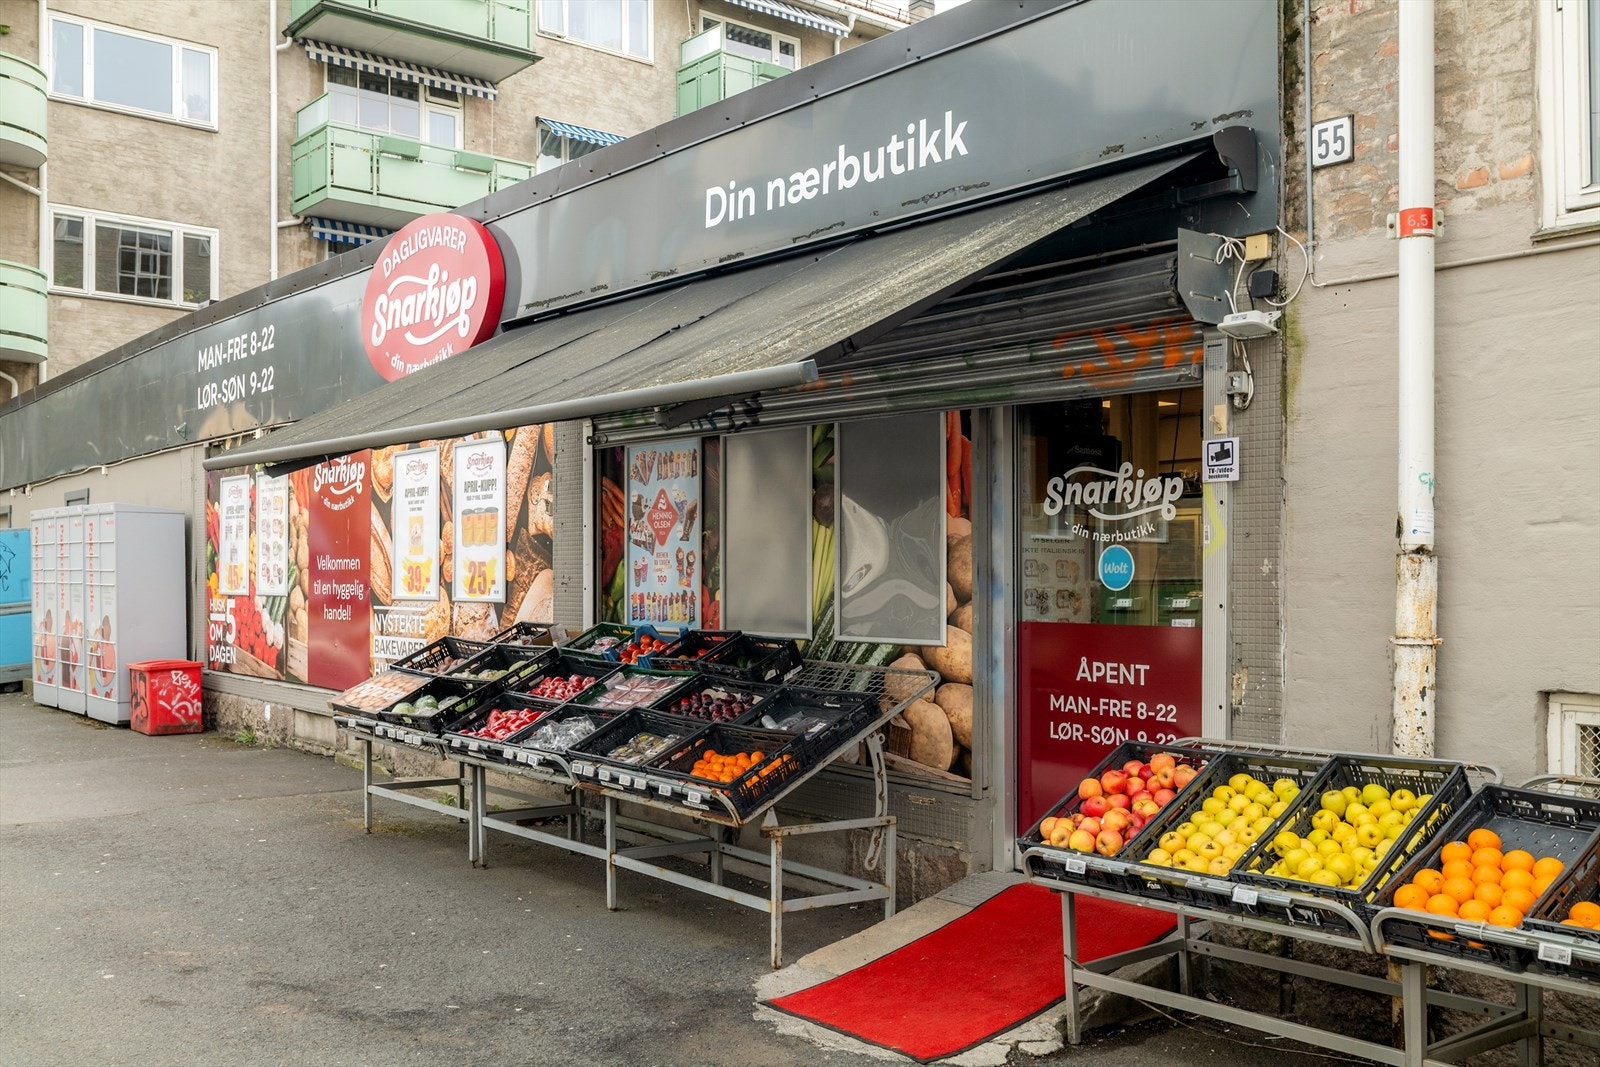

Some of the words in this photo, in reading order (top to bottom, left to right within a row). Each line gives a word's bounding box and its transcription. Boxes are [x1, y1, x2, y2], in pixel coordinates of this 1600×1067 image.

[1317, 124, 1345, 159] 55
[705, 180, 755, 229] Din
[766, 110, 969, 211] nærbutikk
[1407, 214, 1429, 228] 6,5
[382, 225, 467, 278] DAGLIGVARER
[371, 262, 477, 347] Snarkjøp
[198, 333, 248, 373] MAN-FRE
[250, 324, 275, 355] 8-22
[391, 353, 405, 373] din
[197, 374, 246, 410] LØR-SØN
[249, 365, 275, 396] 9-22
[314, 455, 366, 495] Snarkjøp
[1043, 462, 1183, 521] Snarkjøp
[652, 512, 673, 520] HENNIG
[653, 521, 671, 529] OLSEN
[1072, 523, 1089, 539] din
[1092, 522, 1156, 542] nærbutikk
[316, 555, 361, 571] Velkommen
[1104, 562, 1129, 575] Wolt
[313, 580, 322, 595] til
[322, 583, 332, 595] en
[332, 579, 364, 600] hyggelig
[209, 598, 226, 612] HUSK
[323, 604, 352, 621] handel!
[226, 598, 237, 644] 5
[374, 613, 426, 634] NYSTEKTE
[209, 623, 223, 642] OM
[209, 645, 237, 665] DAGEN
[1076, 656, 1150, 686] ÅPENT
[1050, 694, 1132, 718] MAN-FRE
[1136, 702, 1177, 723] 8-22
[1050, 721, 1129, 746] LØR-SØN
